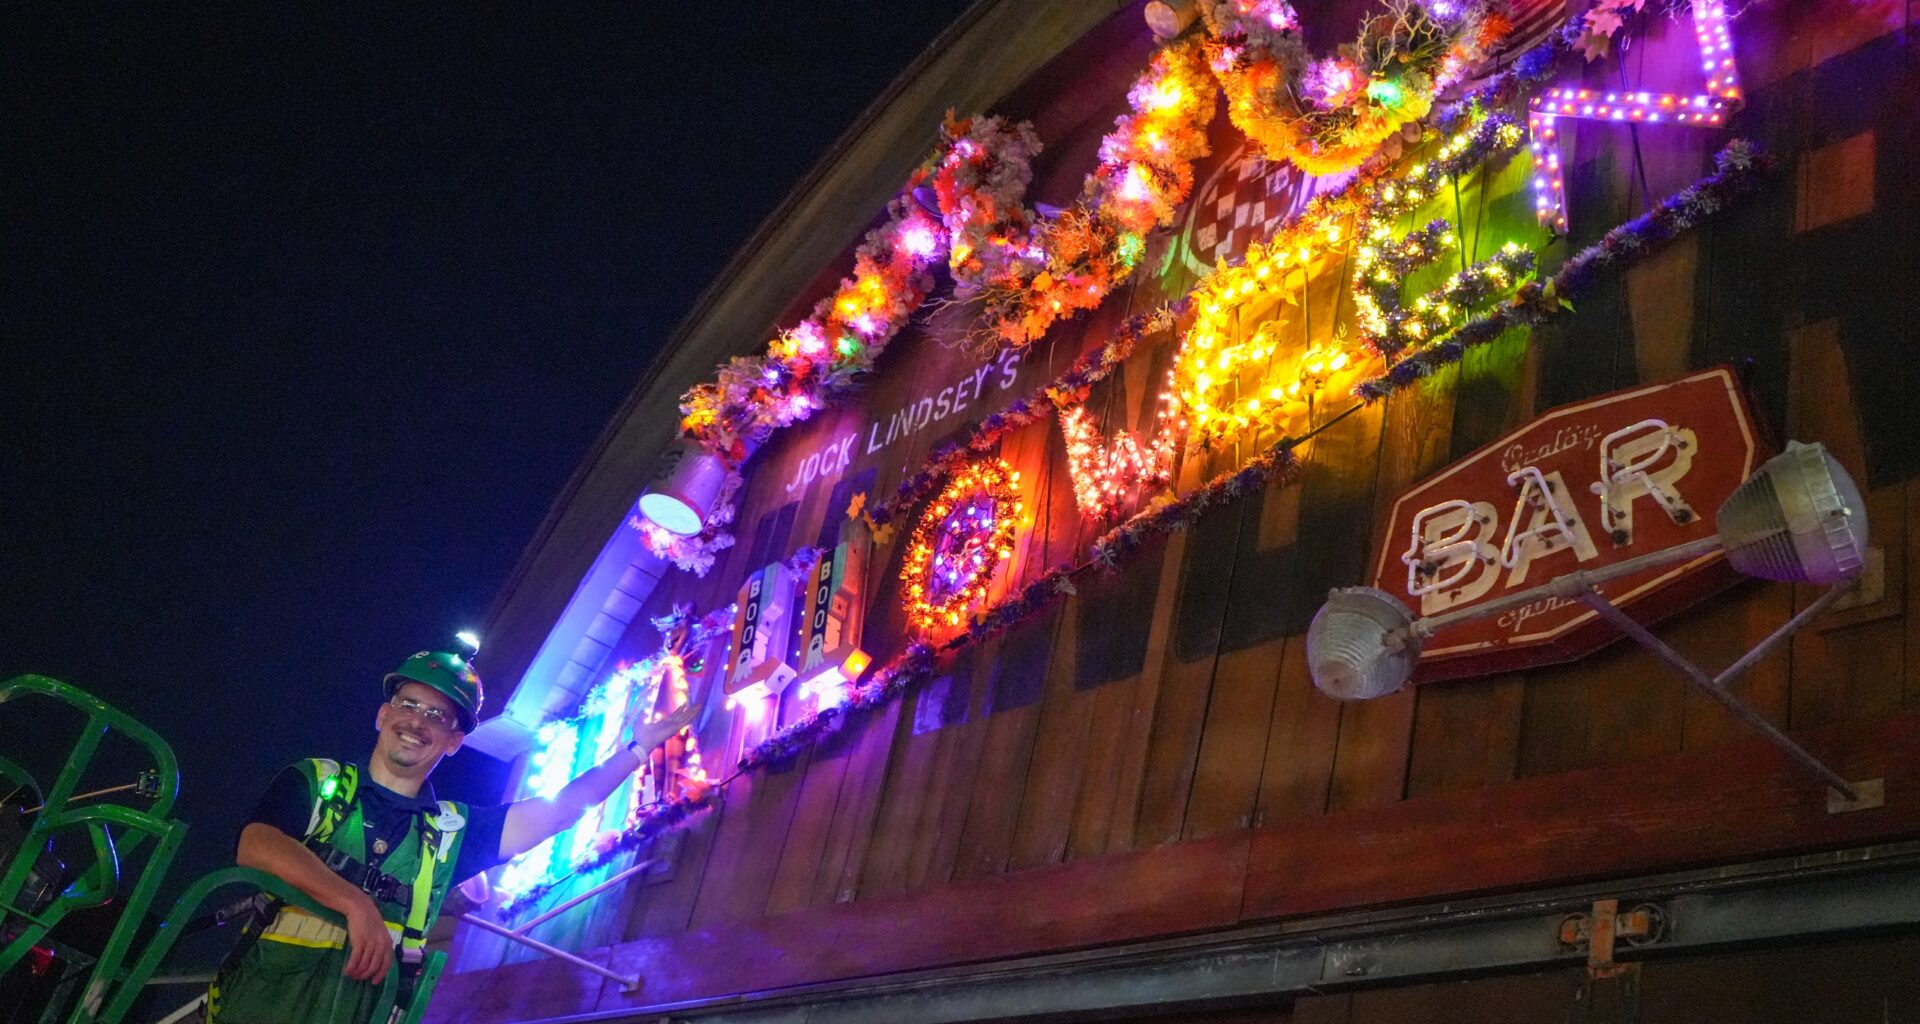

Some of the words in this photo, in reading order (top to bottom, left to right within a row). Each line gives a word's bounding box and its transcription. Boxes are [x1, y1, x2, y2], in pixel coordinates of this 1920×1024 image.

[786, 433, 858, 492] JOCK
[867, 348, 1020, 454] LINDSEY'S
[1402, 418, 1701, 616] BAR
